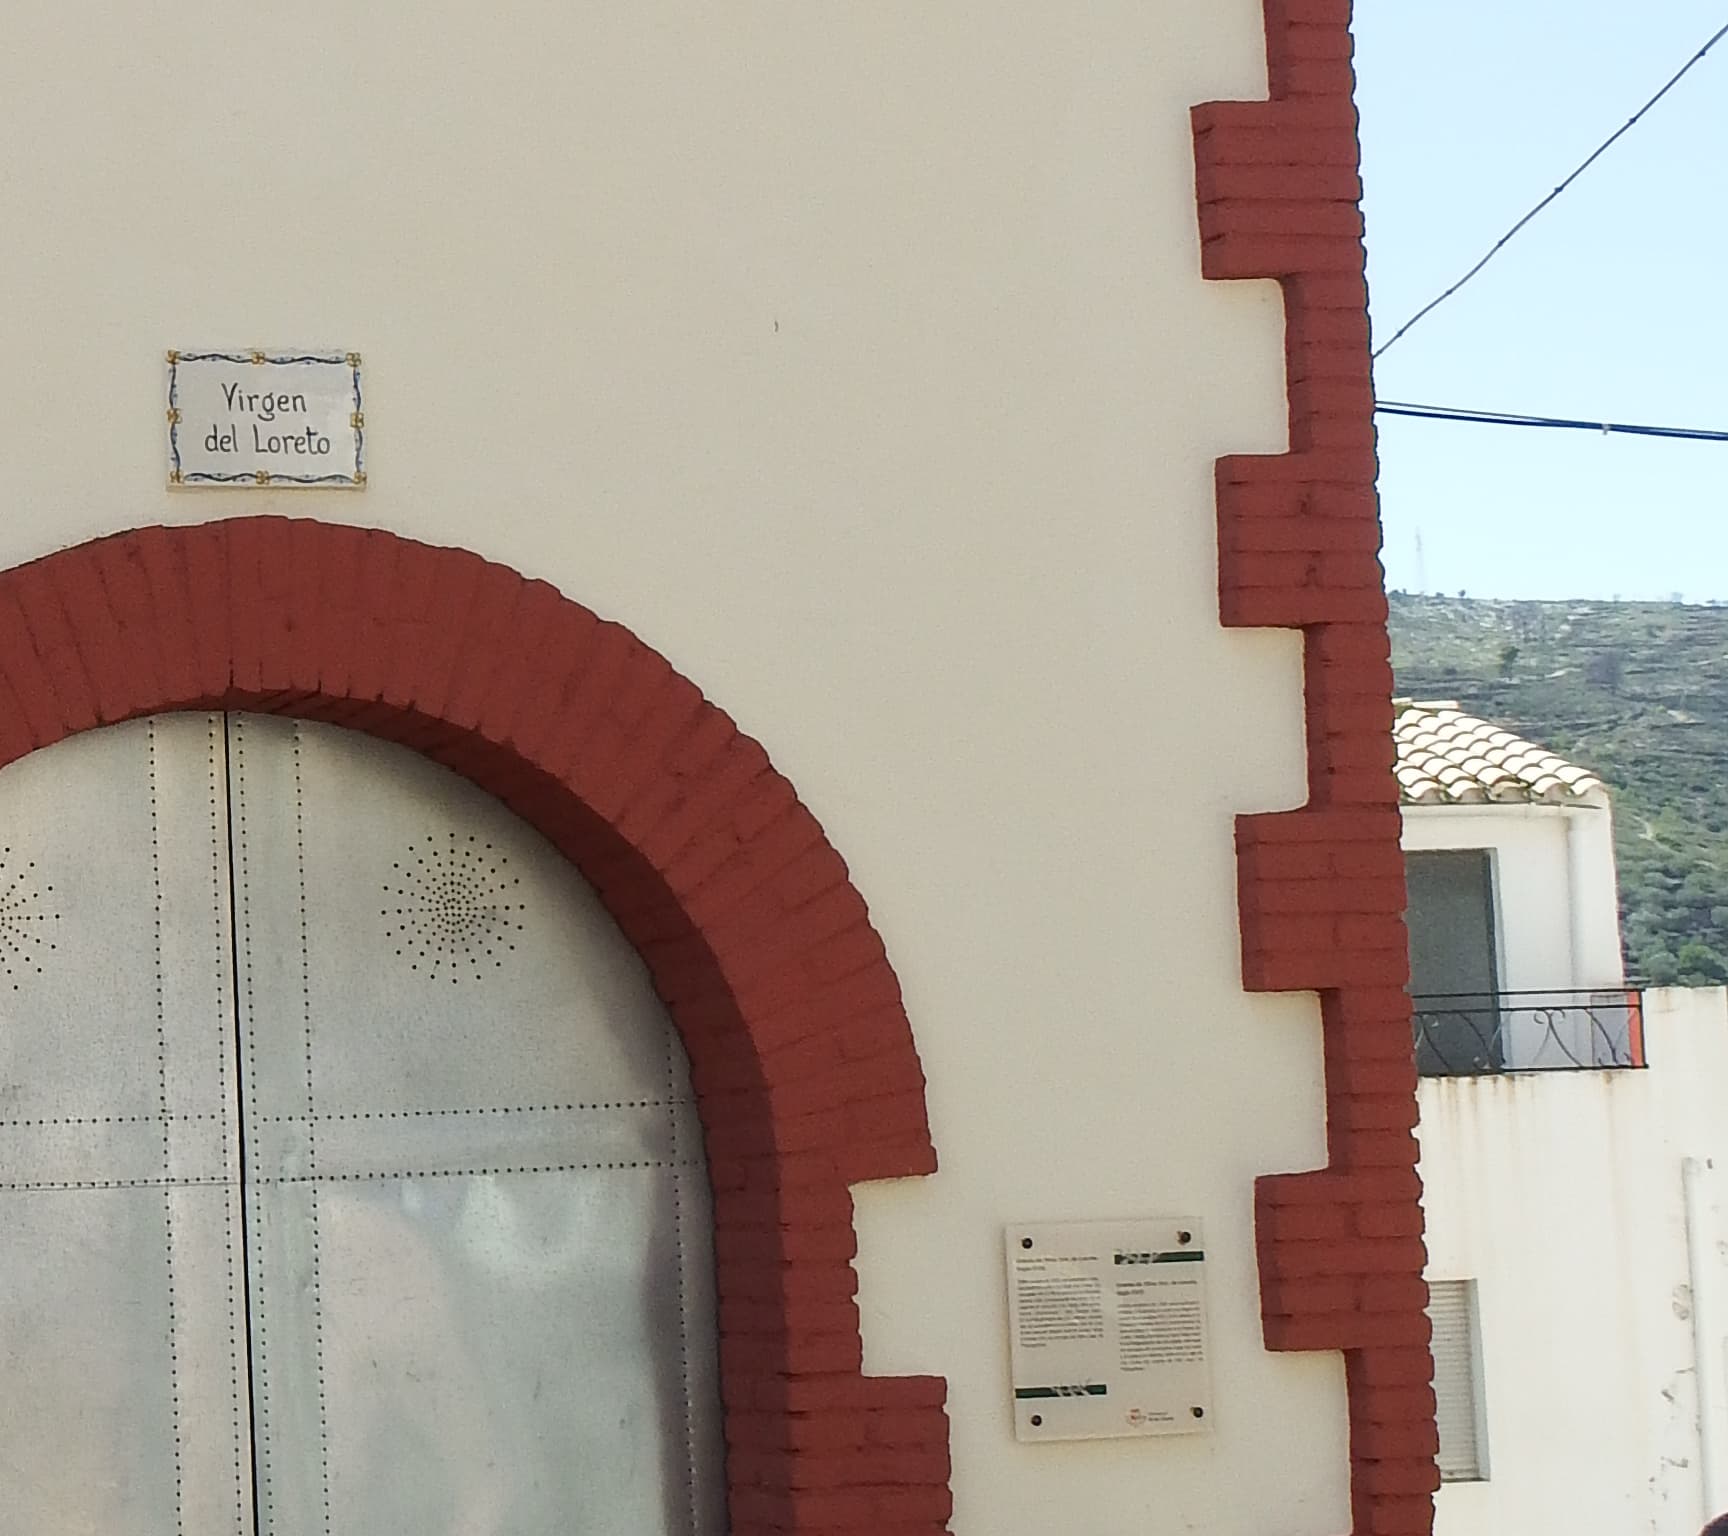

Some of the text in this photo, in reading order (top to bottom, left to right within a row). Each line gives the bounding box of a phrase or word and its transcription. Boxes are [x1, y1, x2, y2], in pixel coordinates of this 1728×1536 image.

[221, 382, 307, 421] Virgen
[204, 424, 331, 454] del Loreto
